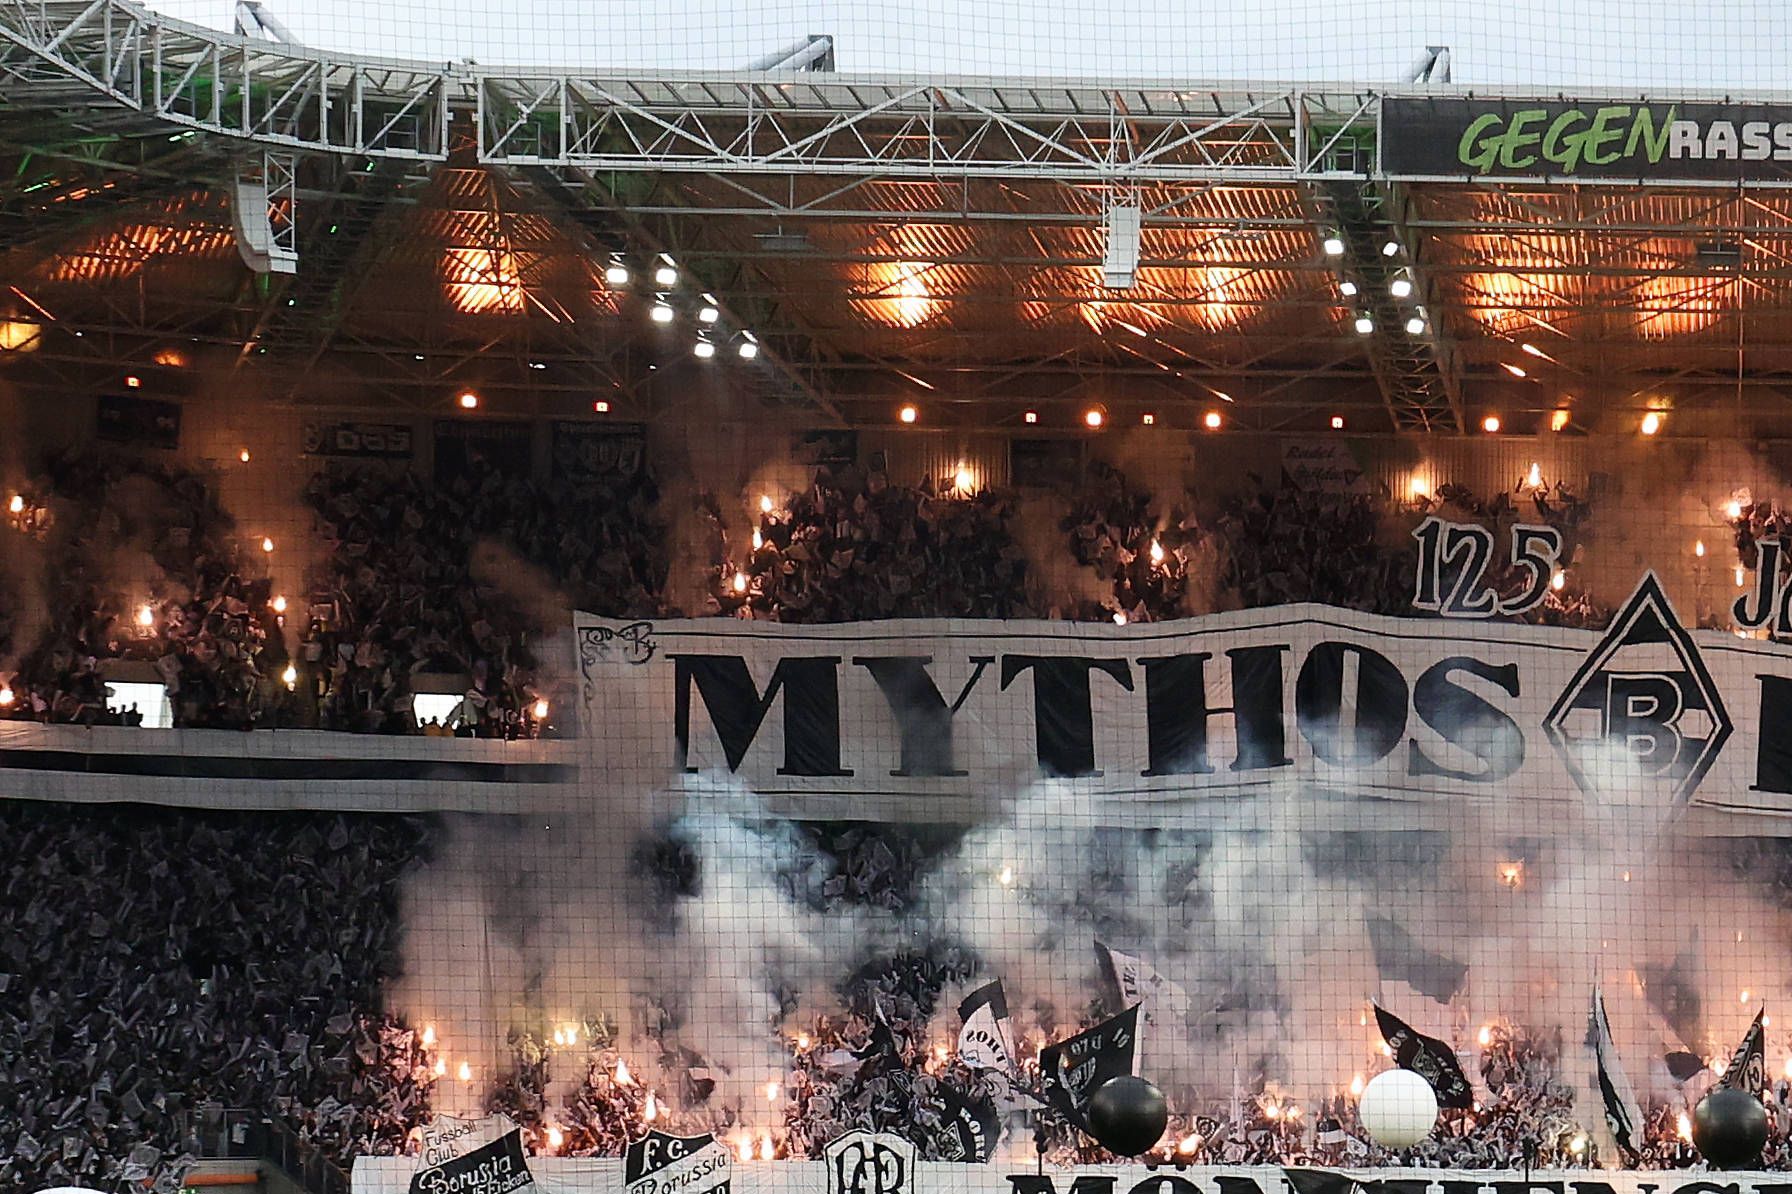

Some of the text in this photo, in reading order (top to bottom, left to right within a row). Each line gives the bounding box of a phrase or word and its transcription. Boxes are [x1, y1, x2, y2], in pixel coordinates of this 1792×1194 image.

[1458, 104, 1676, 175] GEGEN
[1411, 516, 1563, 618] 125
[664, 641, 1526, 784] MYTHOS
[426, 1121, 477, 1147] Fussball
[426, 1148, 458, 1167] Club
